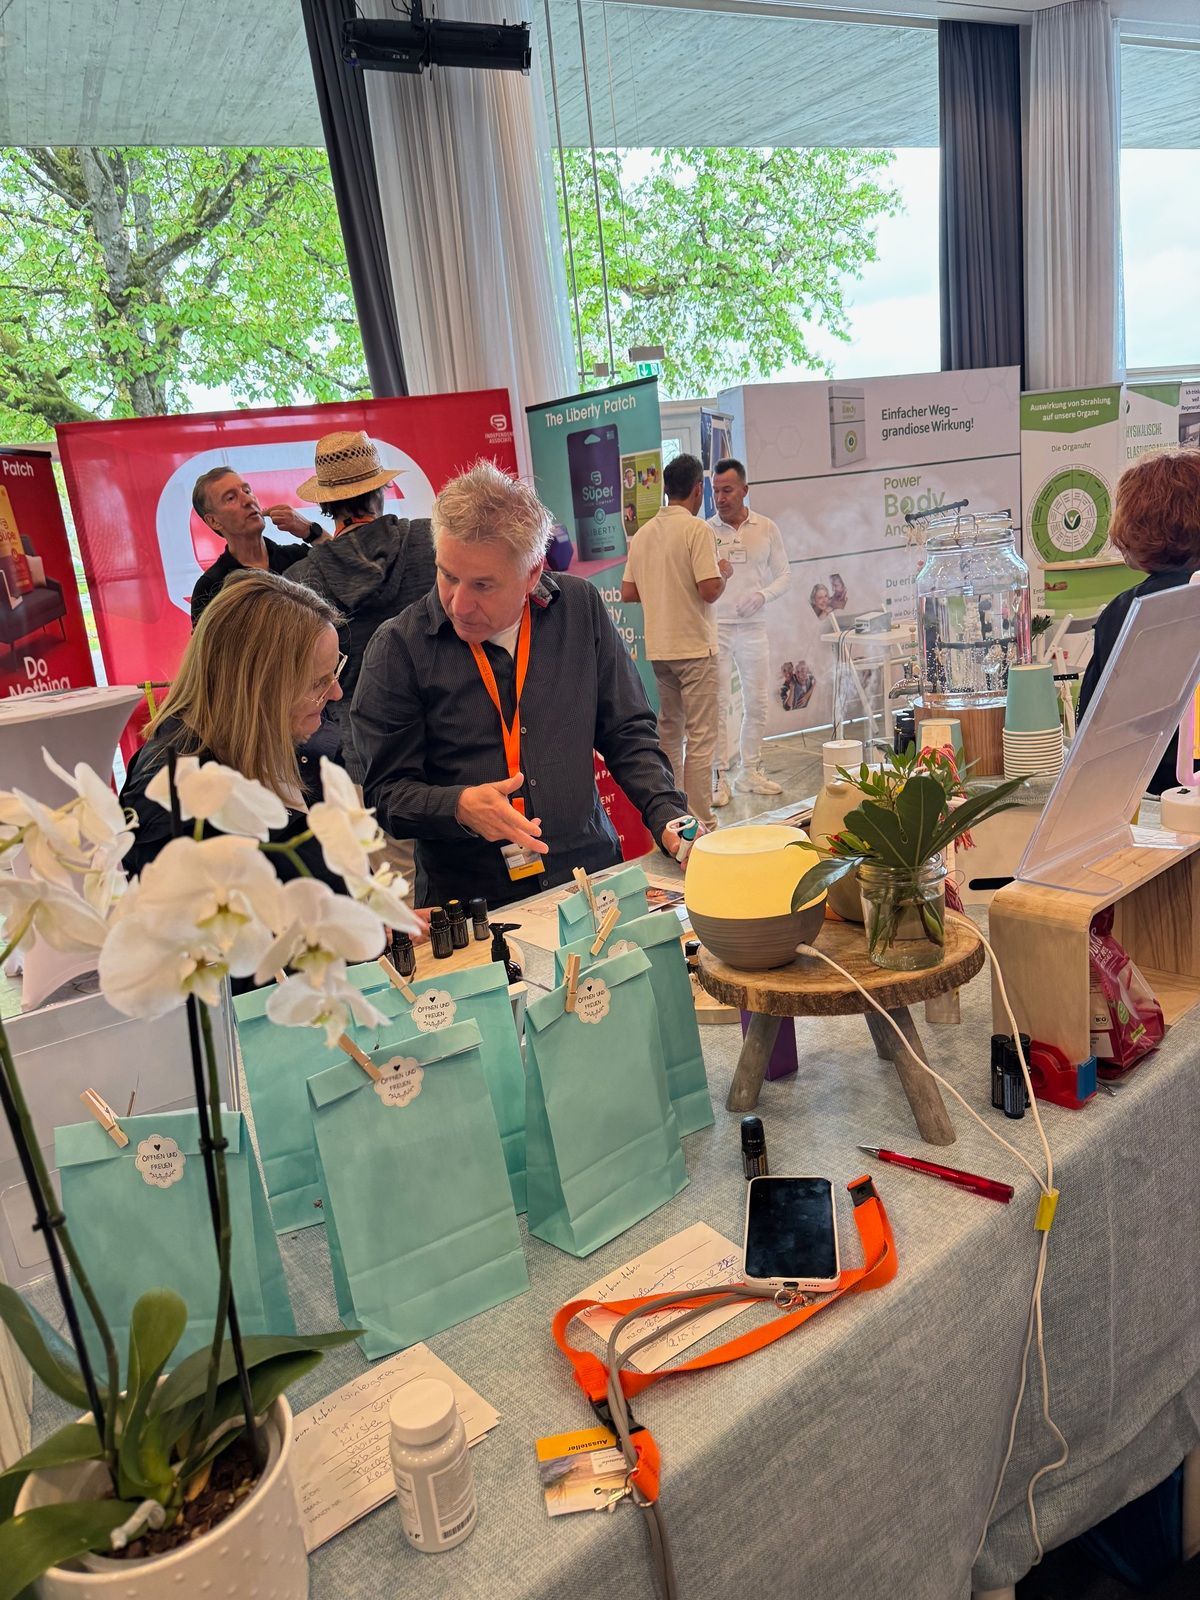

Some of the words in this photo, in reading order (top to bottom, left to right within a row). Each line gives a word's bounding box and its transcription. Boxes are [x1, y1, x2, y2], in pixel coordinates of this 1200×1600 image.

[545, 412, 563, 427] The
[565, 403, 601, 423] Liberty
[604, 394, 637, 414] Patch
[1030, 400, 1067, 412] Auswirkung
[1068, 400, 1080, 408] von
[1080, 396, 1111, 408] Strahlung
[881, 406, 928, 421] Einfacher
[928, 404, 950, 418] Weg
[1042, 413, 1053, 421] auf
[1054, 411, 1076, 420] unsere
[1076, 409, 1099, 419] Organe
[881, 423, 930, 441] grandiose
[931, 418, 975, 433] Wirkung!
[1051, 444, 1061, 452] Die
[1062, 441, 1092, 452] Organuhr
[2, 460, 35, 477] Patch
[883, 475, 922, 490] Power
[886, 579, 898, 588] Du
[23, 656, 48, 680] Do
[567, 1439, 608, 1452] Aussteller
